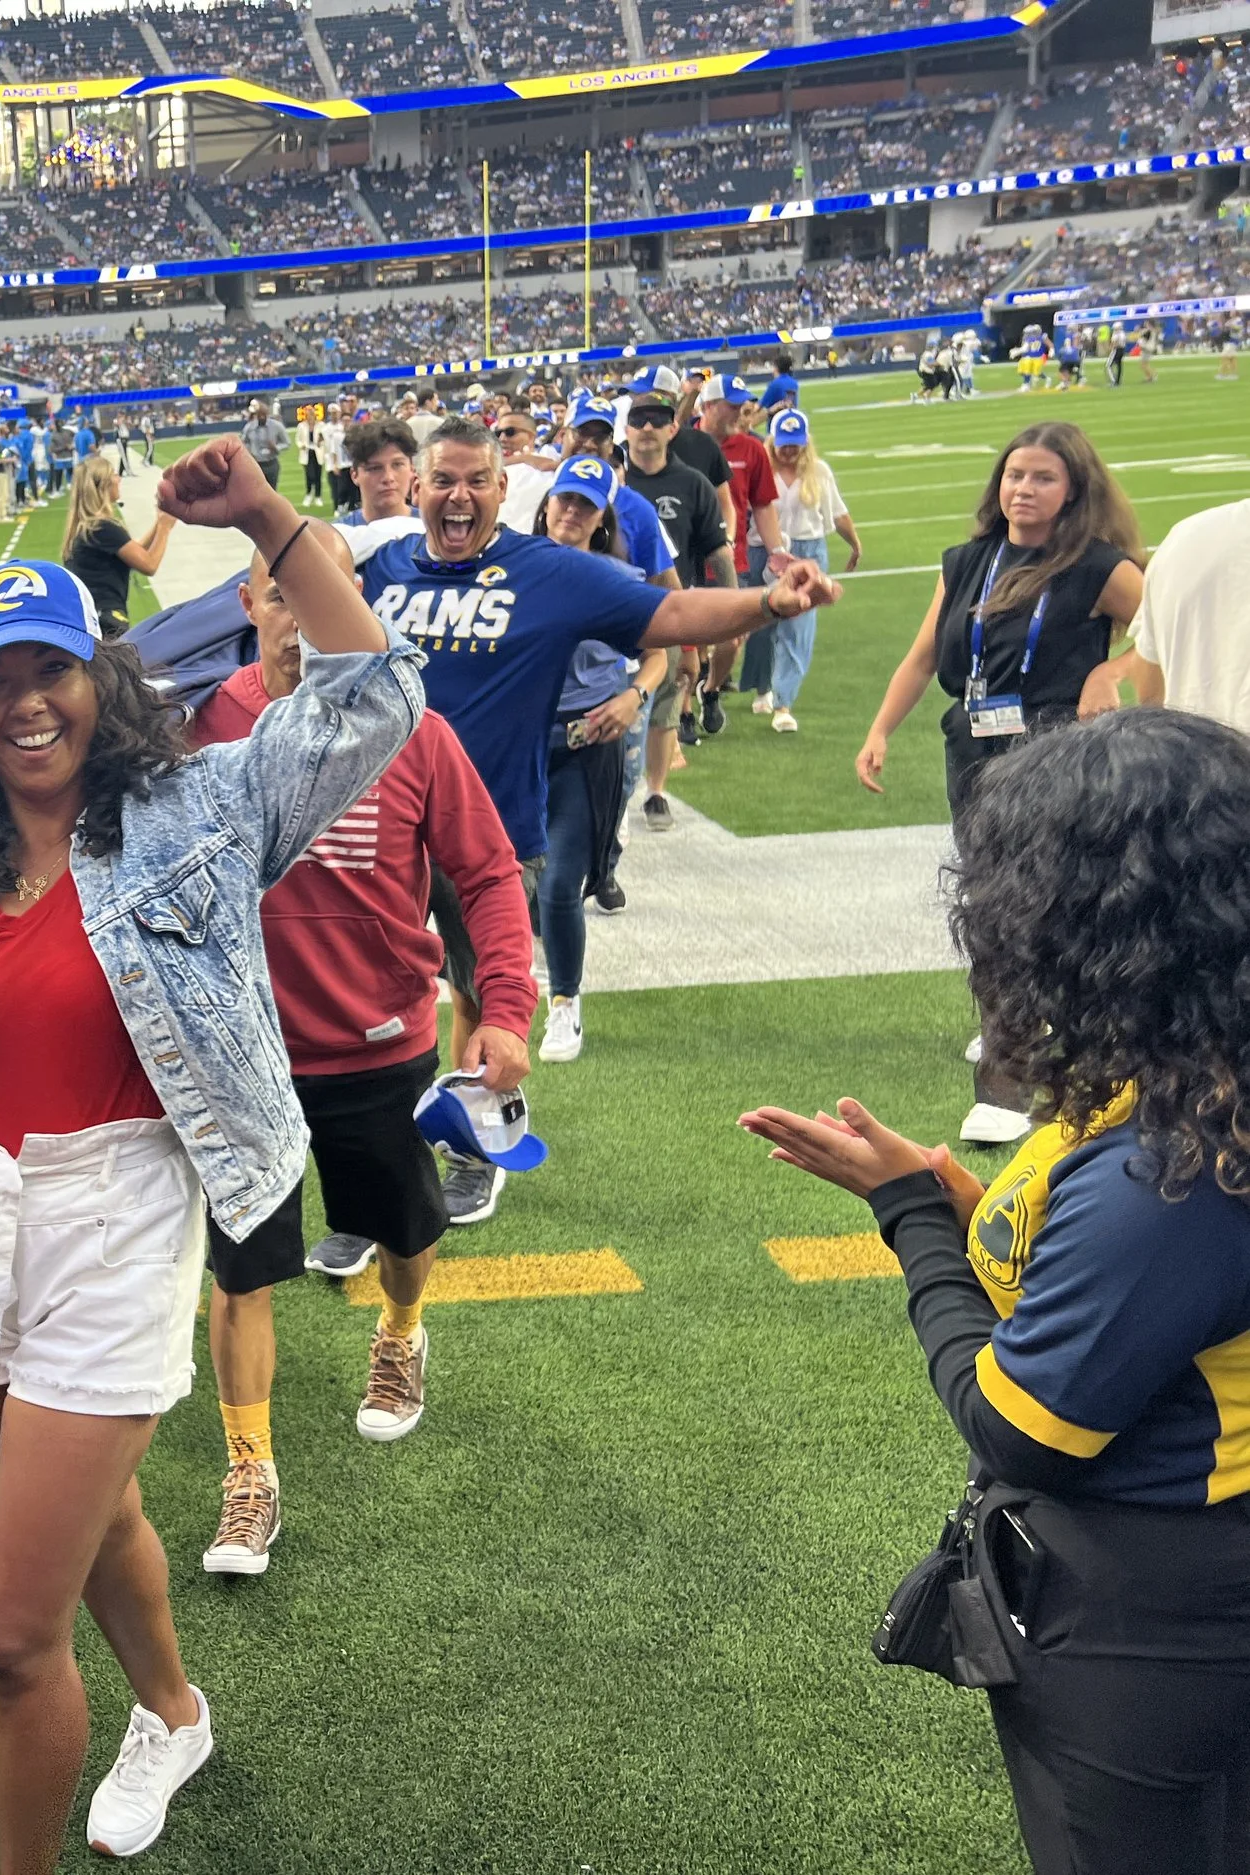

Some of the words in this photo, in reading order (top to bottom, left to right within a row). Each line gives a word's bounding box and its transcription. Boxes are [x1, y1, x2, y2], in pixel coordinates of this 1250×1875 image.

[2, 85, 78, 97] ANGELES
[570, 76, 604, 89] LOS
[611, 64, 698, 83] ANGELES
[870, 175, 1017, 206] WELCOME
[1036, 168, 1074, 186] TO
[1093, 160, 1151, 179] THE
[372, 584, 516, 639] RAMS
[970, 1236, 1003, 1281] CSC
